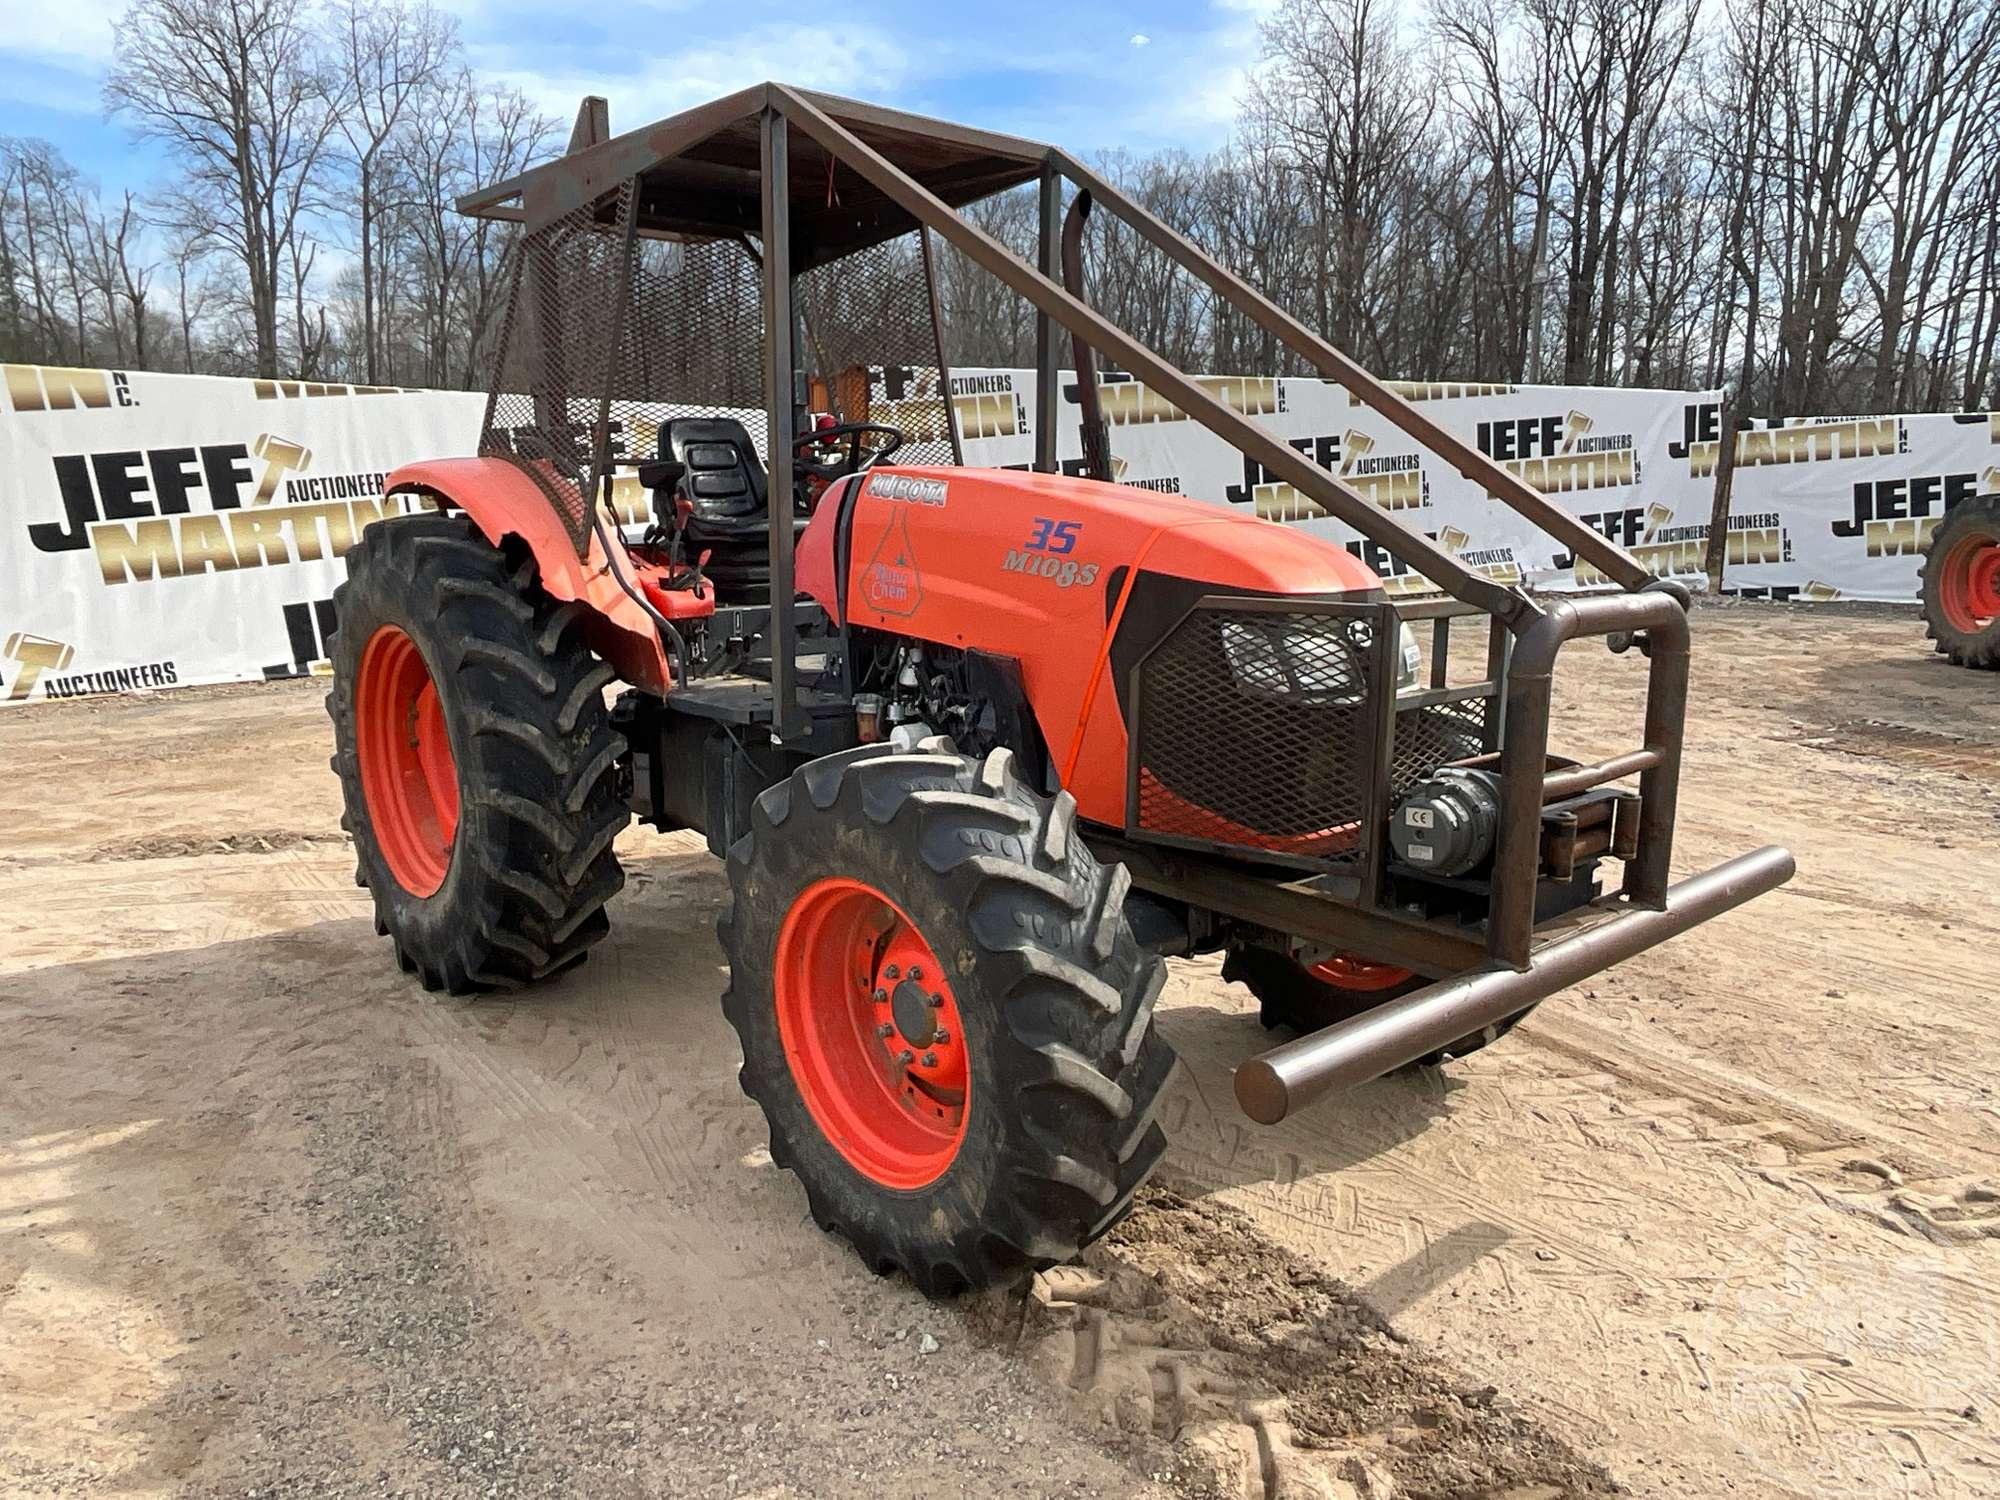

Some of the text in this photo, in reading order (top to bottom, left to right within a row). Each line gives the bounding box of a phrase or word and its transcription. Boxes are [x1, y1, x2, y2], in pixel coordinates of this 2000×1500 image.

[951, 374, 1012, 395] CTIONEERS
[1577, 435, 1632, 453] AUCTIONEERS
[1357, 454, 1420, 475] AUCTIONEERS
[28, 444, 253, 553] JEFF
[866, 474, 946, 507] KUBOTA
[1832, 473, 1977, 537] JEFF
[1024, 517, 1082, 554] 35
[1001, 549, 1100, 588] M108S
[44, 661, 178, 699] AUCTIONEERS
[1412, 811, 1426, 824] CE
